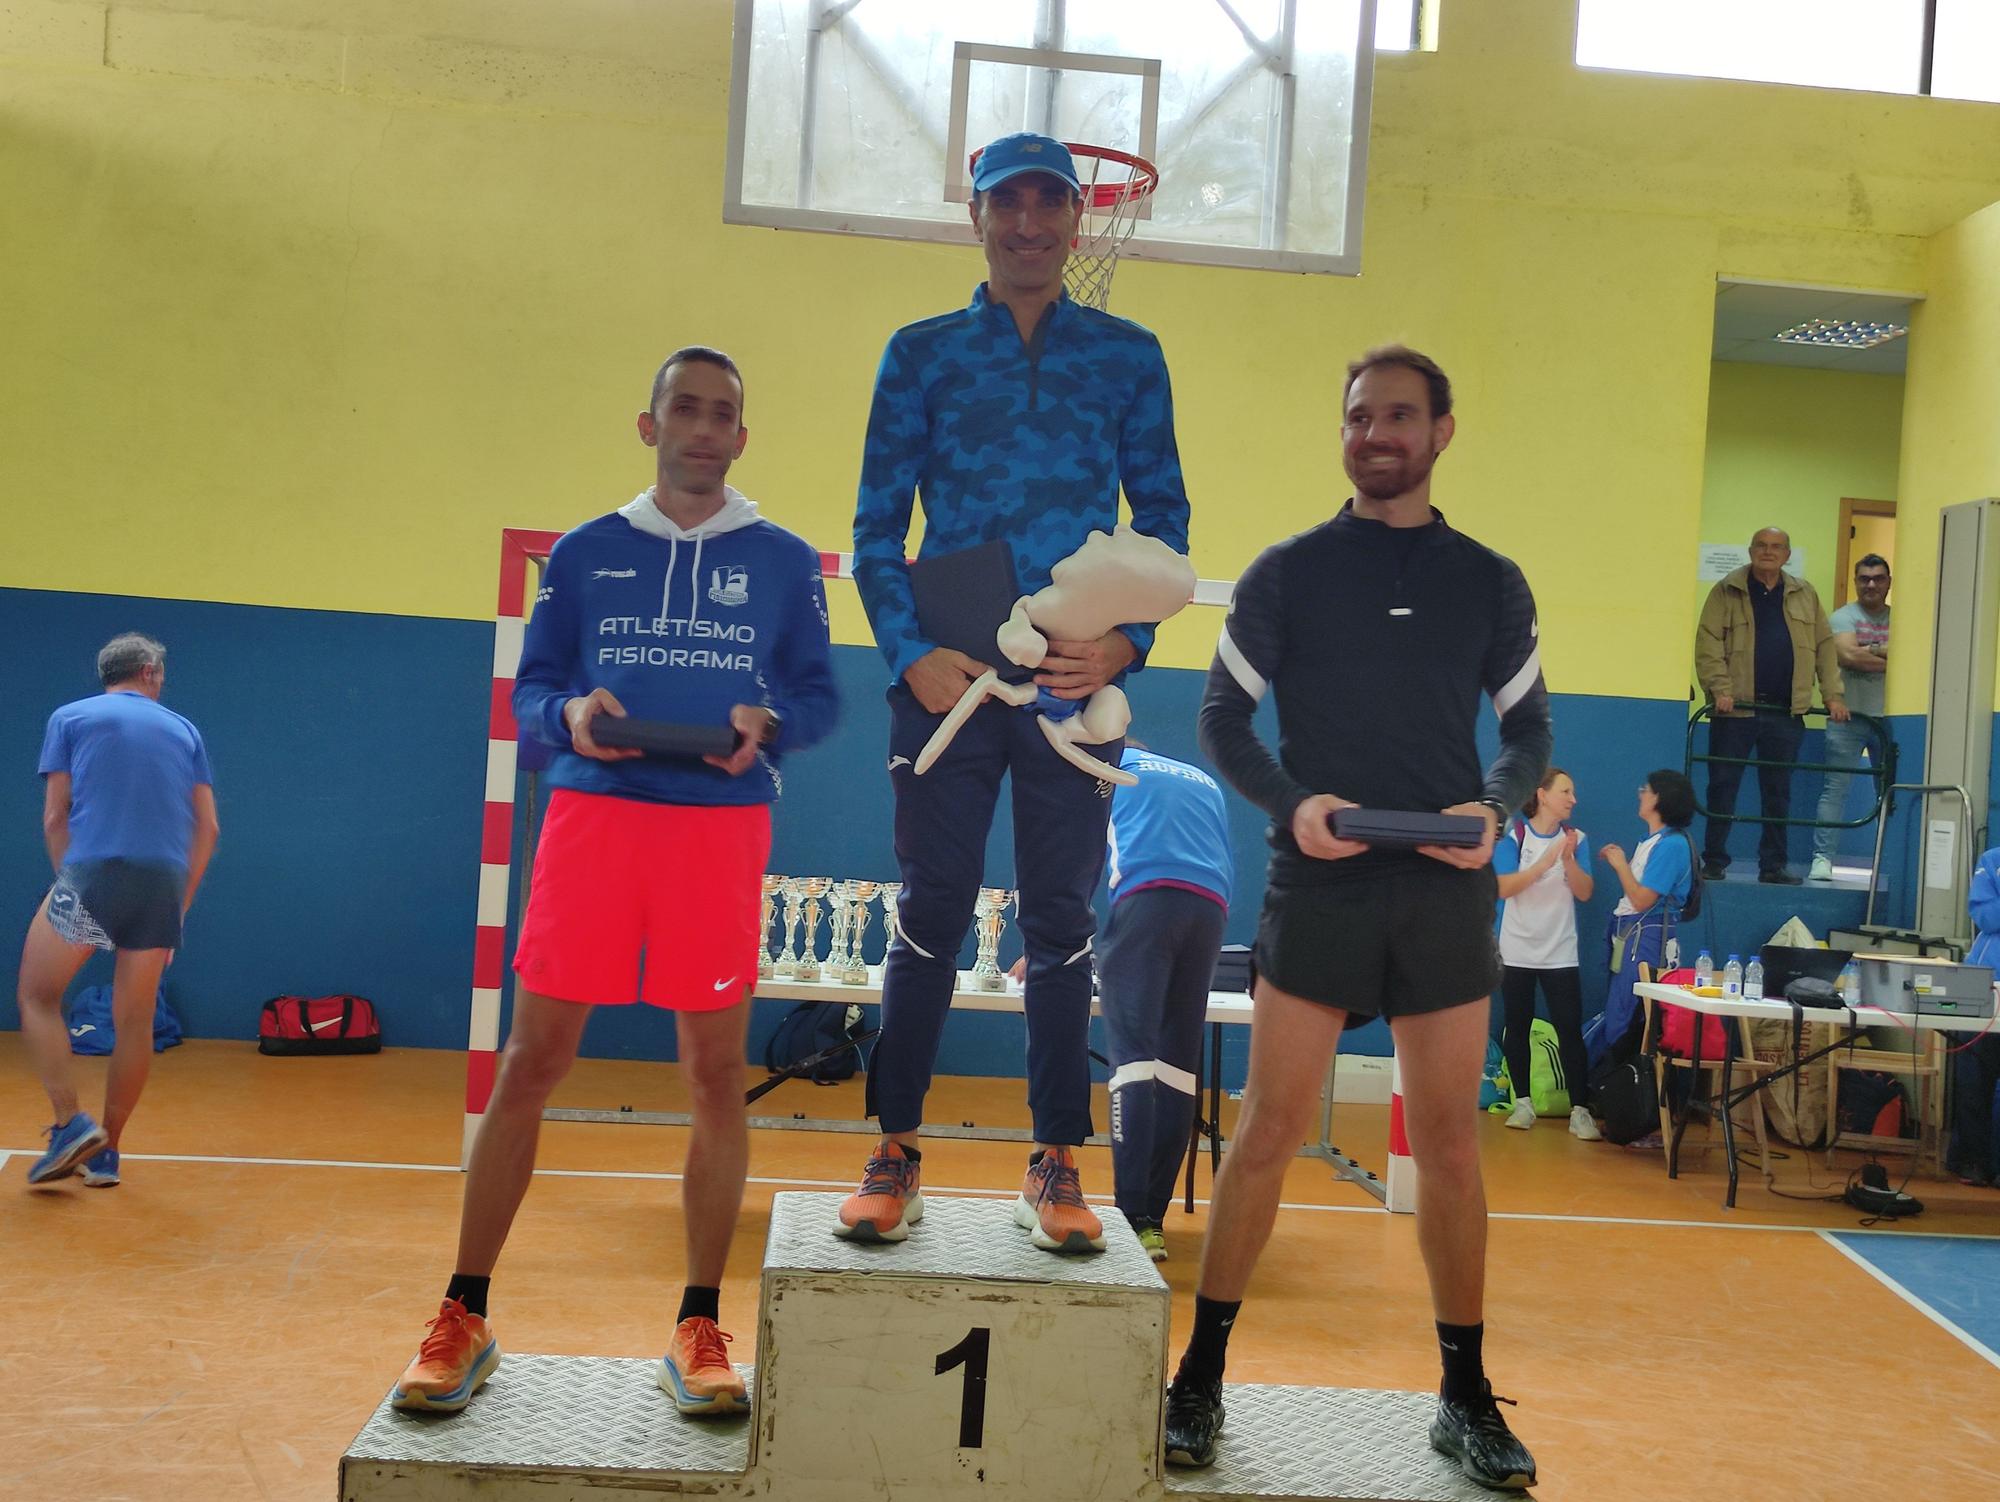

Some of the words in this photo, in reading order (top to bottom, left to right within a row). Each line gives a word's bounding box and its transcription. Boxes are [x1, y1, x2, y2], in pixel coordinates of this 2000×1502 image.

[599, 616, 756, 644] ATLETISMO
[598, 646, 753, 672] FISIORAMA
[934, 1327, 991, 1449] 1
